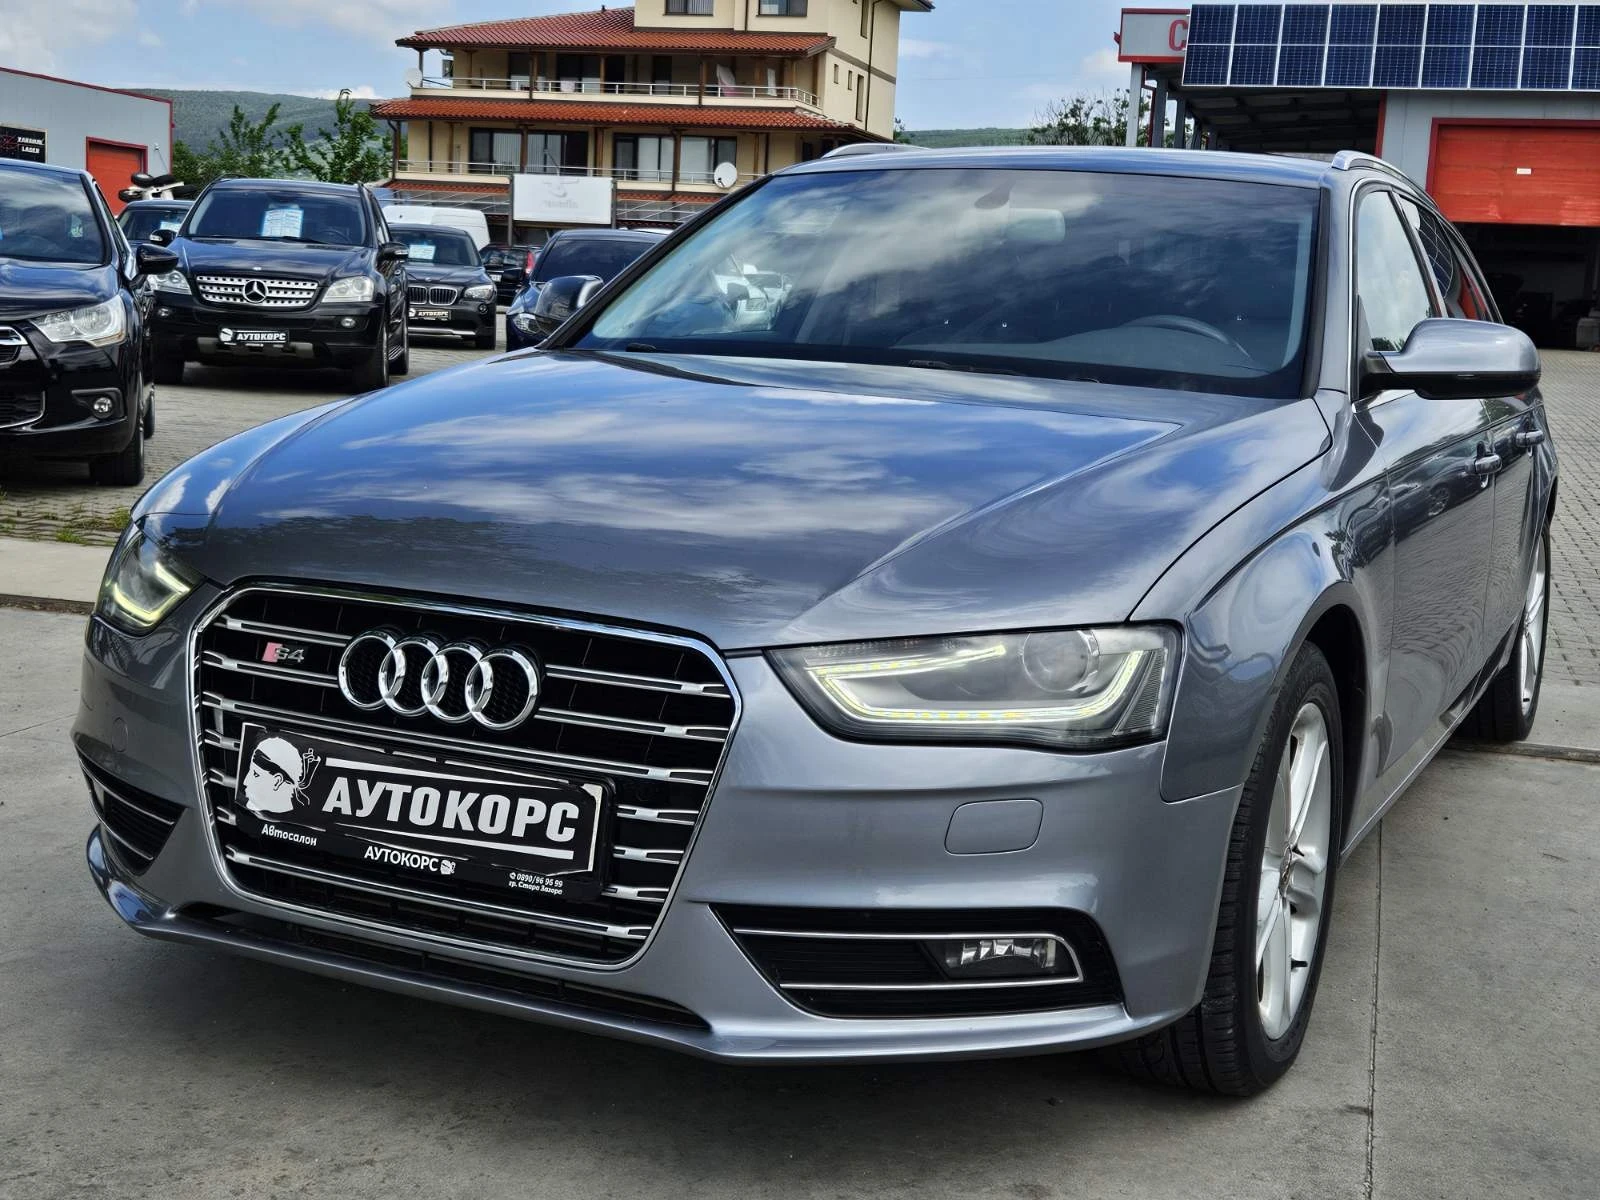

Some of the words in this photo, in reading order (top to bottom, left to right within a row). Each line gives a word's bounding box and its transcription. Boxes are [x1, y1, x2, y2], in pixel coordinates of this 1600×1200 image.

[236, 332, 287, 341] АУТОКОРС
[272, 646, 305, 663] S4
[321, 776, 579, 843] АУТОКОРС
[261, 823, 317, 846] Автосалон
[364, 845, 439, 872] АУТОКОРС
[518, 881, 540, 891] Стара
[540, 884, 563, 895] Загора
